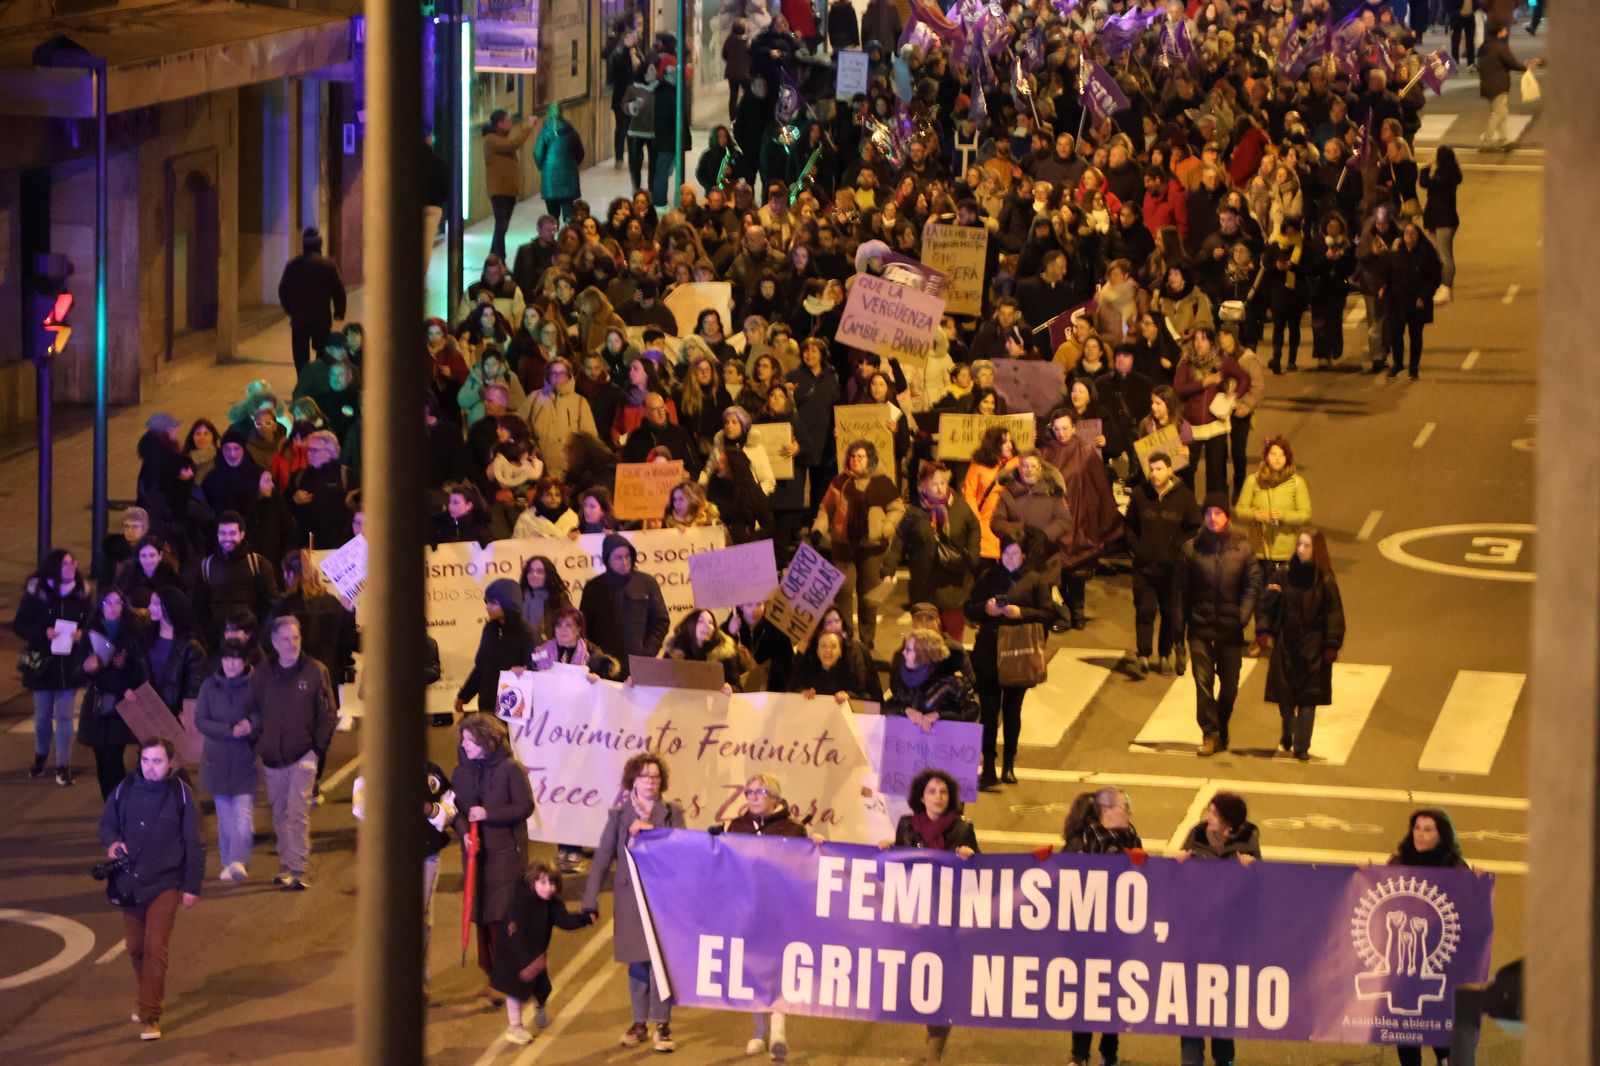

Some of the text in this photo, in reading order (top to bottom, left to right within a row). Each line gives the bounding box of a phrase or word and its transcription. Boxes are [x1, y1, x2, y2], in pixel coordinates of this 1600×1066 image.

[859, 276, 902, 298] QUE LA
[891, 327, 930, 359] BANDO
[425, 560, 478, 579] ismo
[486, 560, 512, 575] no
[769, 546, 818, 622] MI CUERPO
[787, 560, 840, 641] MIS REGLAS
[514, 710, 846, 767] Movimiento Feminista
[884, 735, 977, 764] FEMINISMO
[816, 855, 1169, 943] FEMINISMO,
[696, 934, 1290, 1031] EL GRITO NECESARIO
[1342, 1014, 1399, 1029] Asamblea
[1402, 1017, 1442, 1030] abierta
[1380, 1028, 1424, 1043] Zamora
